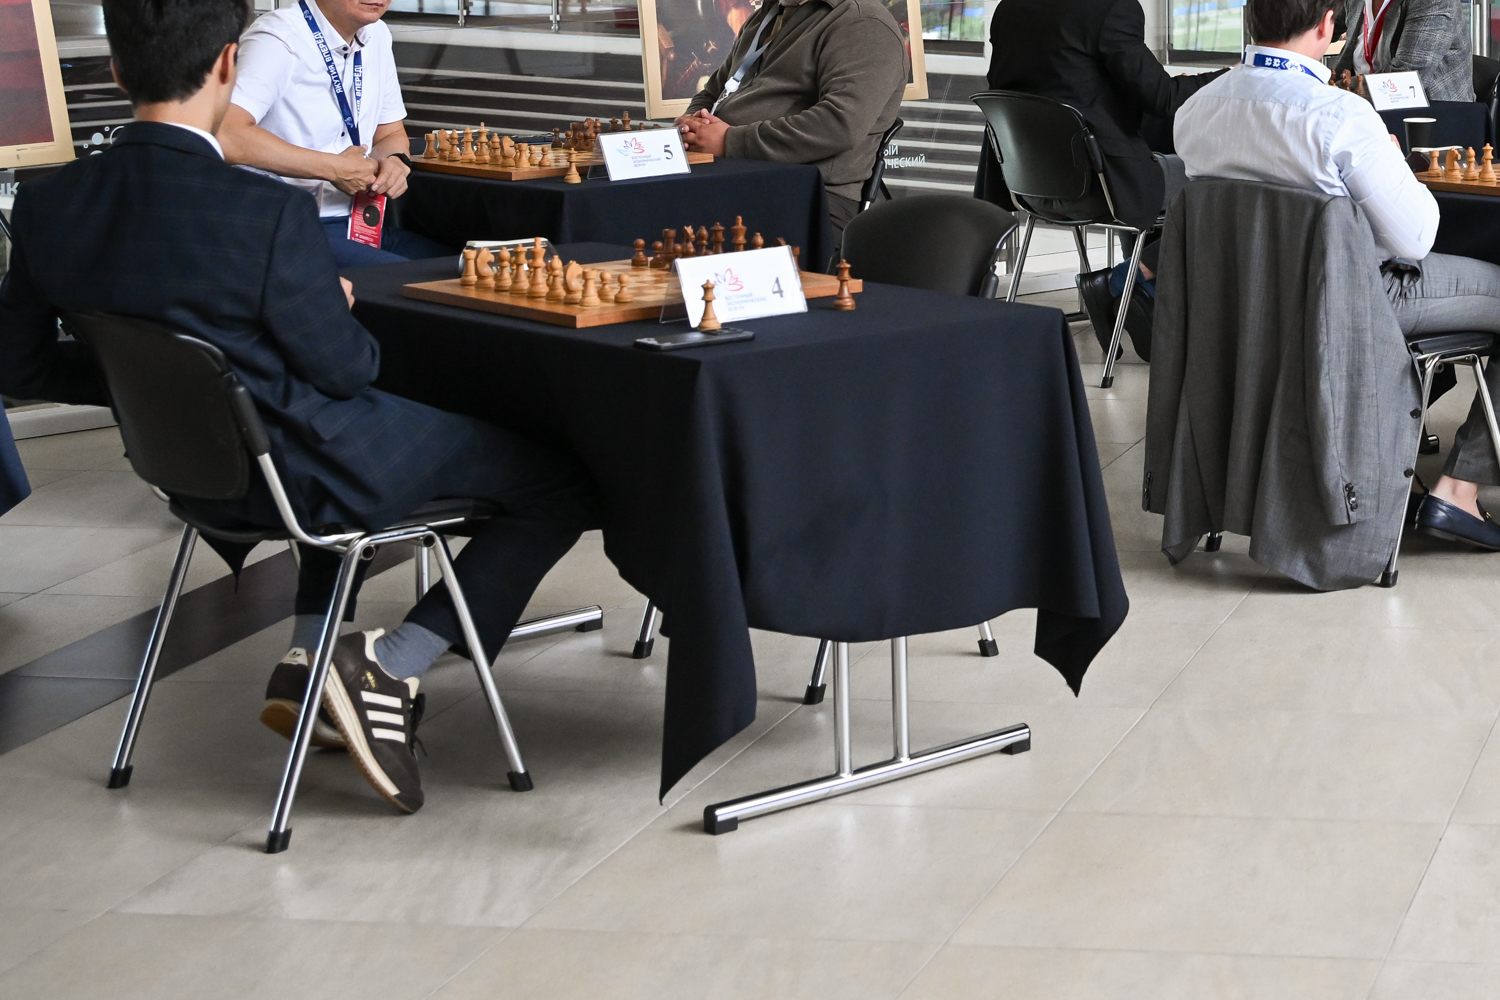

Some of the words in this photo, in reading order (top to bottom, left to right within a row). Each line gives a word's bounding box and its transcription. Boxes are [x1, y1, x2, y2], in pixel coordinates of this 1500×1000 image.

[1408, 85, 1416, 99] 7
[663, 144, 674, 160] 5
[884, 153, 926, 170] ЧЕСКИЙ
[771, 276, 784, 298] 4
